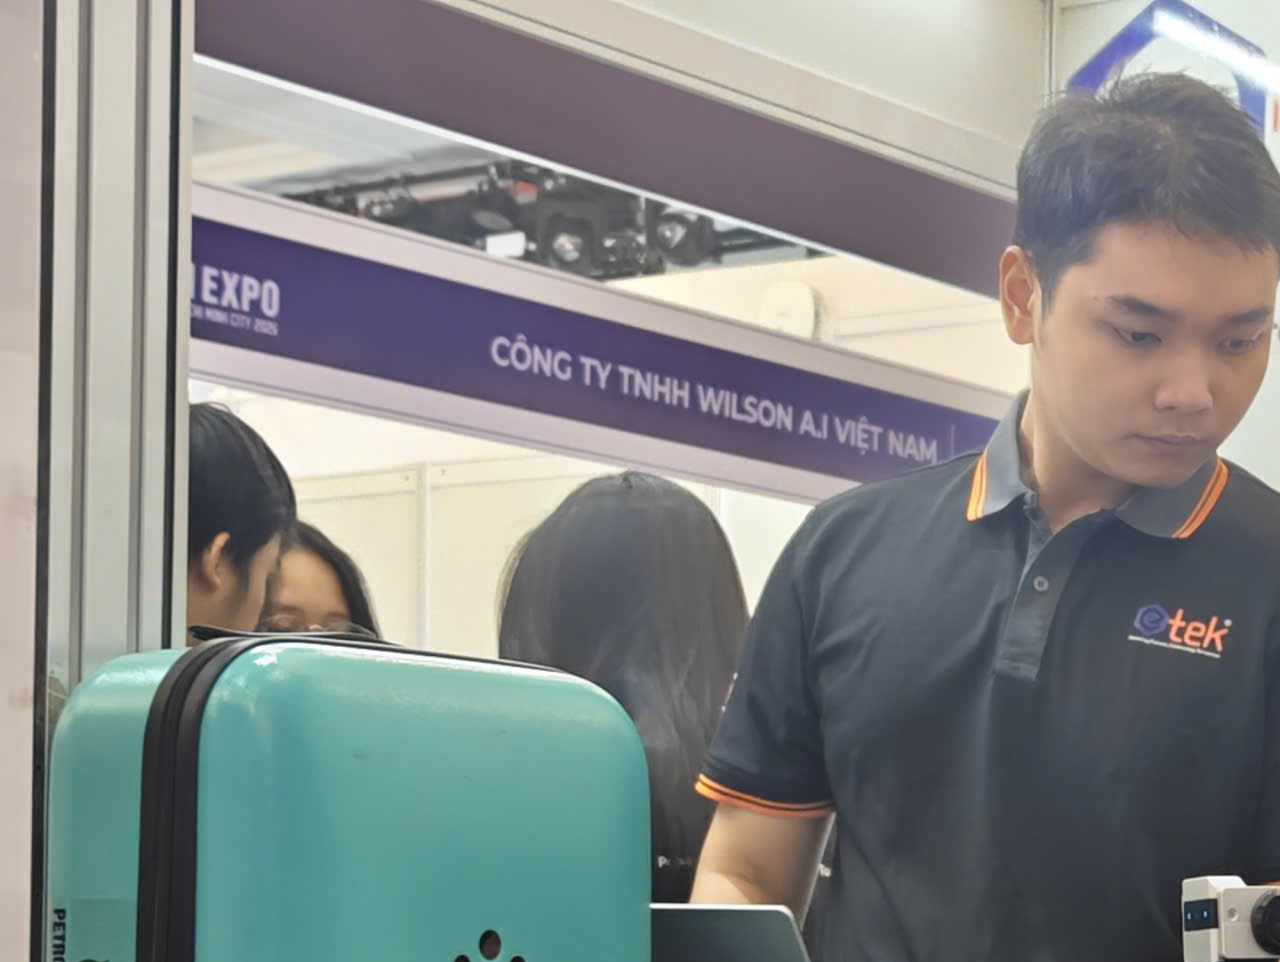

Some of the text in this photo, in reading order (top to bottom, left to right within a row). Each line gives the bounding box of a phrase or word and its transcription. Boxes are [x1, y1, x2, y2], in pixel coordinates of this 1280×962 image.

[201, 264, 280, 318] EXPO
[491, 333, 937, 465] CÔNG TY TNHH WILSON A.I VIỆT NAM
